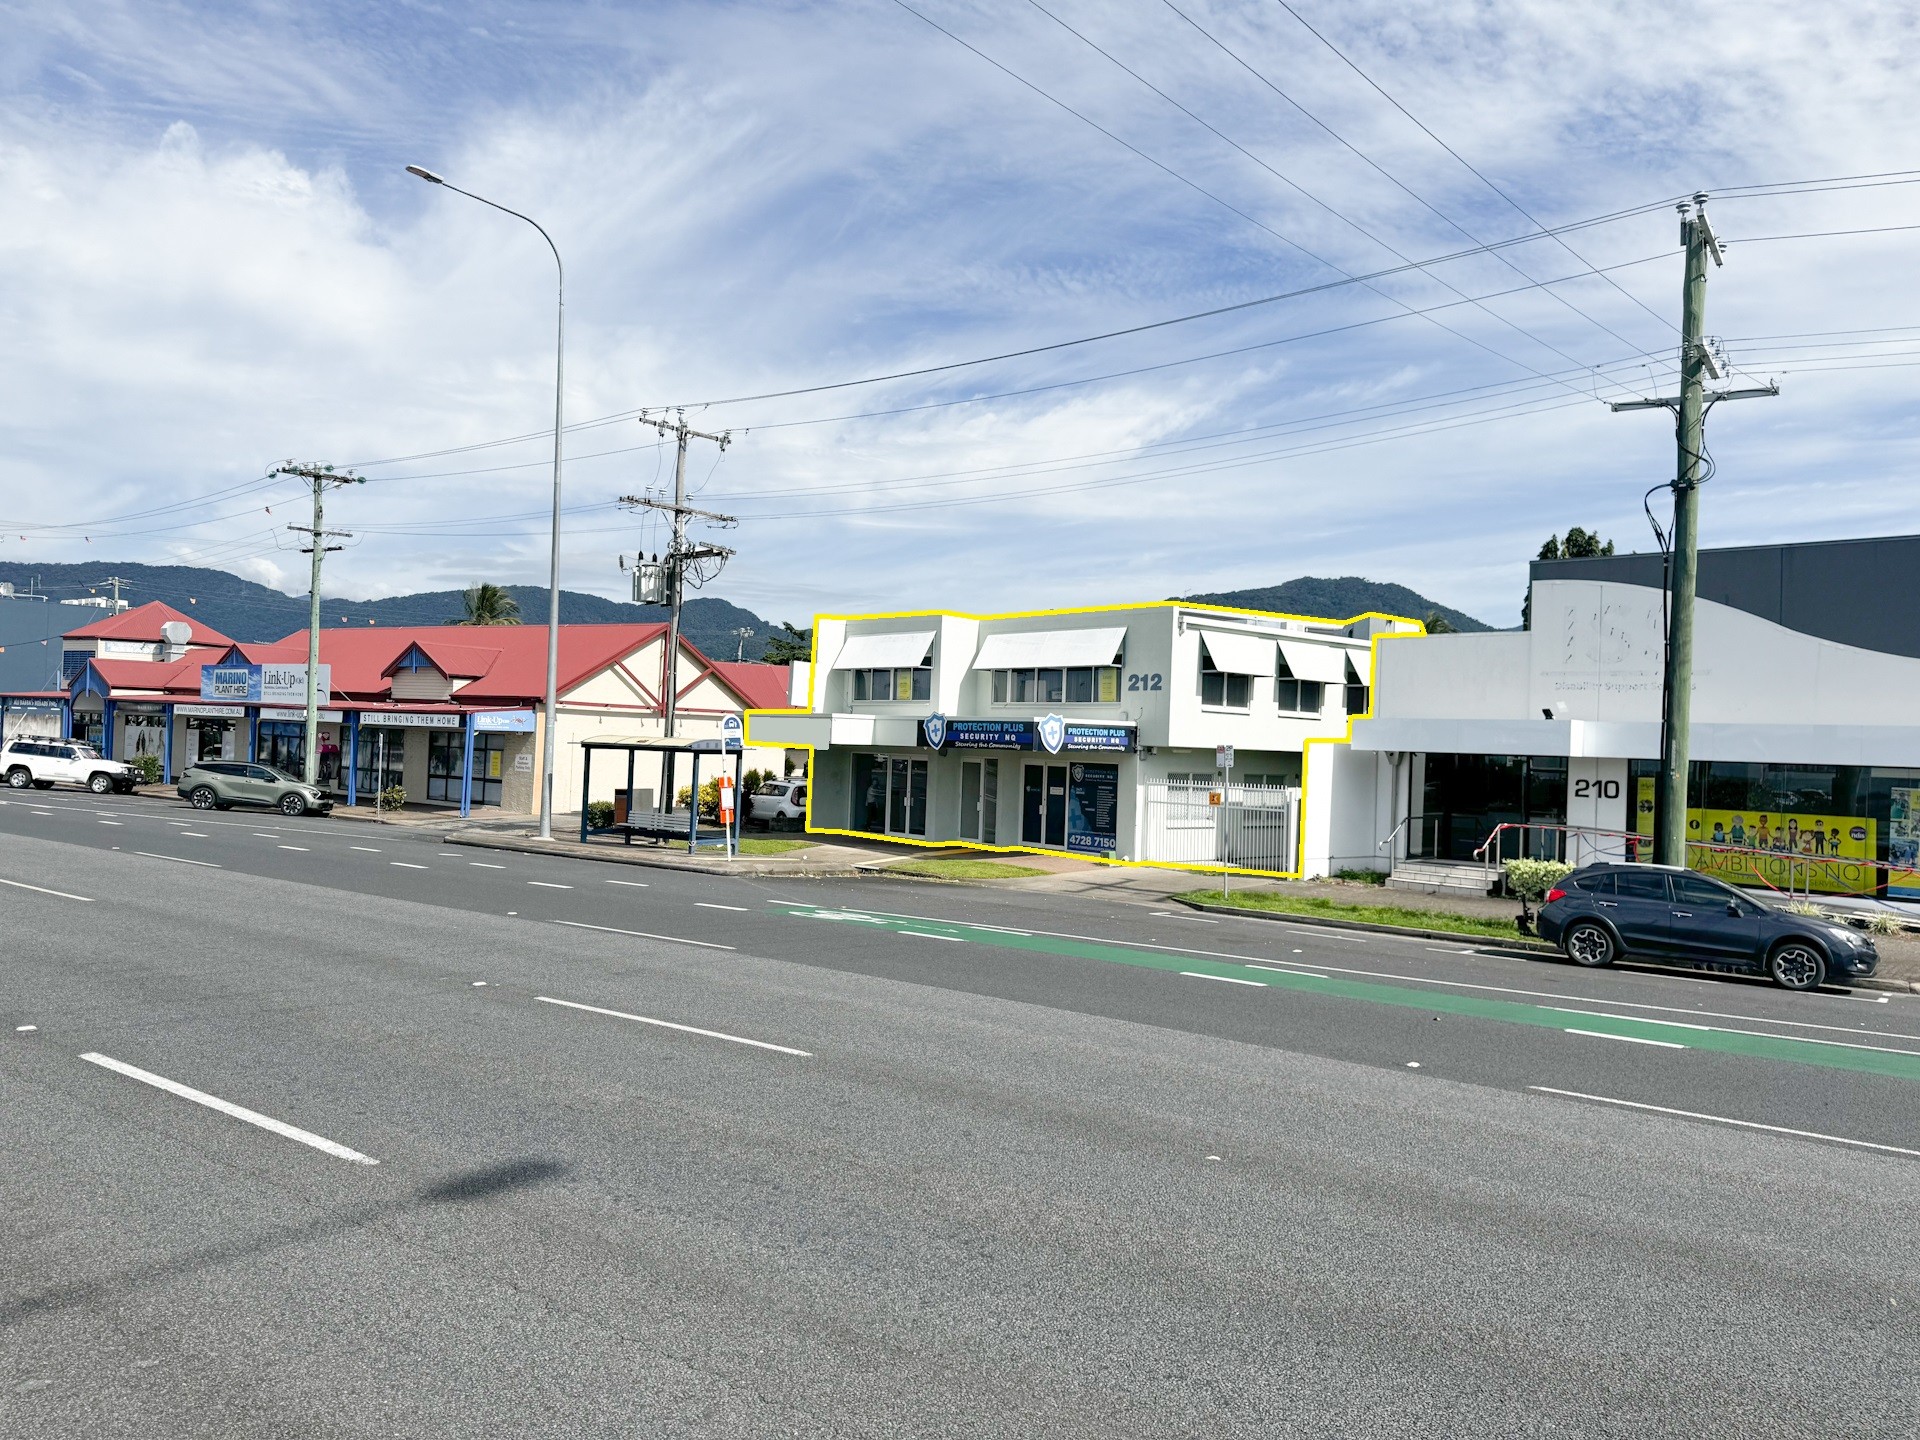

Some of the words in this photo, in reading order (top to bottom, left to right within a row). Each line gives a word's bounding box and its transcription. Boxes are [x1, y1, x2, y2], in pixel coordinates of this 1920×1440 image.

[215, 671, 247, 685] MARINO
[1127, 673, 1163, 692] 212
[214, 685, 233, 694] PLANT
[233, 685, 247, 694] HIRE
[363, 714, 380, 723] STILL
[383, 714, 414, 724] BRINGING
[417, 716, 434, 725] THEM
[437, 716, 456, 725] HOME
[953, 722, 1001, 732] PROTECTION
[1003, 723, 1024, 732] PLUS
[1068, 727, 1108, 736] PROTECTION
[1109, 729, 1125, 737] PLUS
[959, 732, 999, 741] SECURITY
[1004, 734, 1016, 742] NQ
[1073, 736, 1107, 744] SECURITY
[988, 742, 1021, 751] Community
[1098, 744, 1125, 752] Community
[1574, 779, 1620, 799] 210
[1851, 830, 1866, 839] ndis
[1069, 834, 1092, 846] 4728
[1093, 836, 1116, 848] 7150
[1695, 854, 1818, 879] AMBITIONS
[1825, 862, 1861, 882] NQ
